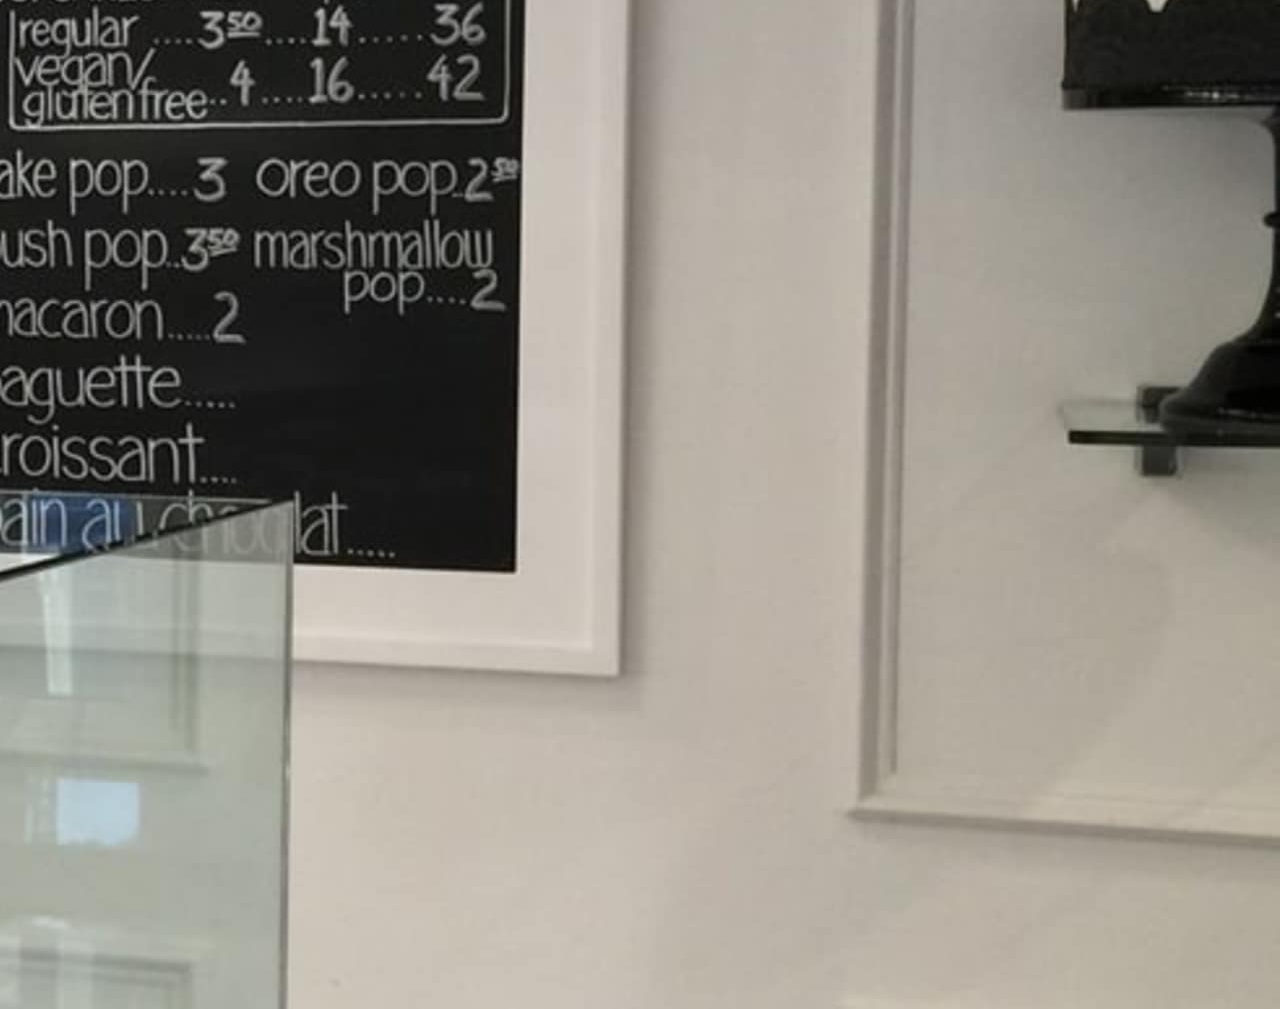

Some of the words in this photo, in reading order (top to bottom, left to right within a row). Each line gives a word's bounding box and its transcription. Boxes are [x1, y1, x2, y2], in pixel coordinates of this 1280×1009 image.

[17, 7, 139, 63] regular
[313, 6, 352, 46] 14
[433, 2, 488, 45] 36
[21, 84, 134, 127] gluten
[229, 59, 255, 107] 4
[308, 58, 355, 103] 16
[426, 53, 486, 101] 42
[193, 157, 227, 202] 3
[255, 159, 361, 198] oreo
[254, 219, 494, 270] marshmallow
[470, 269, 507, 311] 2
[212, 291, 247, 344] 2
